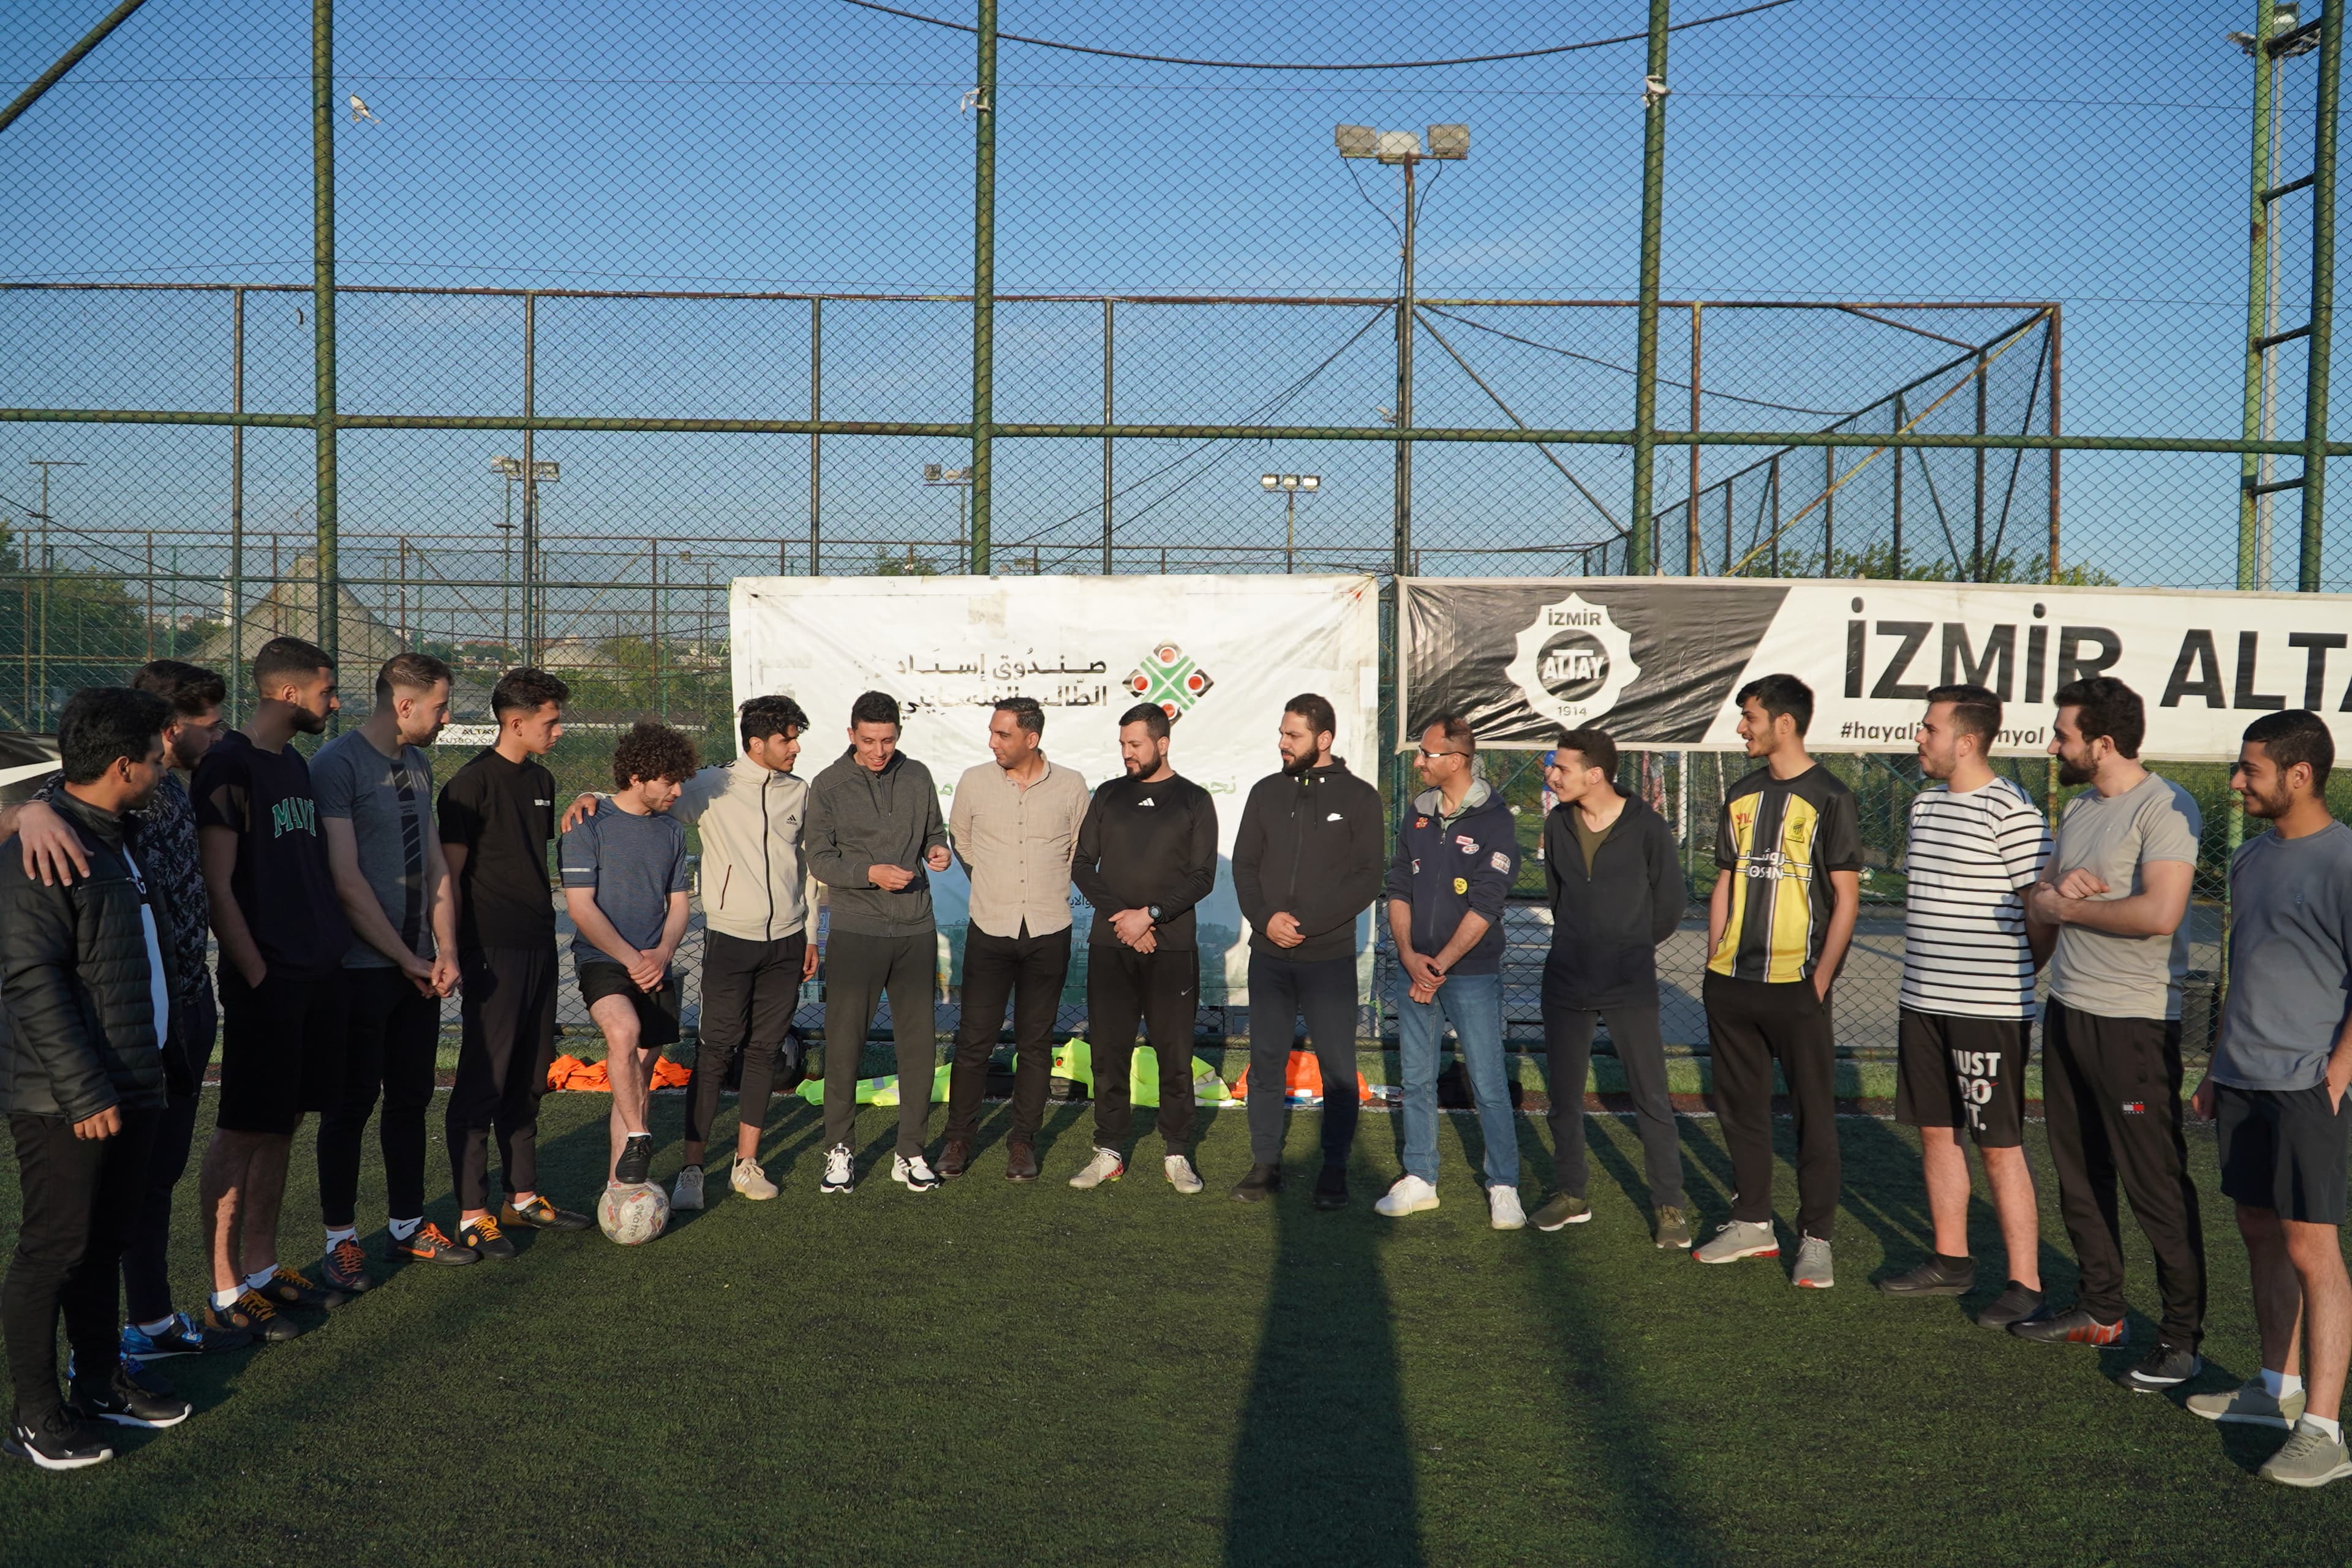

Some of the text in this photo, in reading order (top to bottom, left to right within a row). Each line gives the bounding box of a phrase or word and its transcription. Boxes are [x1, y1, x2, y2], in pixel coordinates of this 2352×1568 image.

[1548, 608, 1602, 626] İZMİR
[1542, 649, 1604, 679] ALTAY
[1844, 597, 2123, 704] İZMİR
[1558, 706, 1588, 716] 1914
[1958, 1076, 1992, 1104] DO
